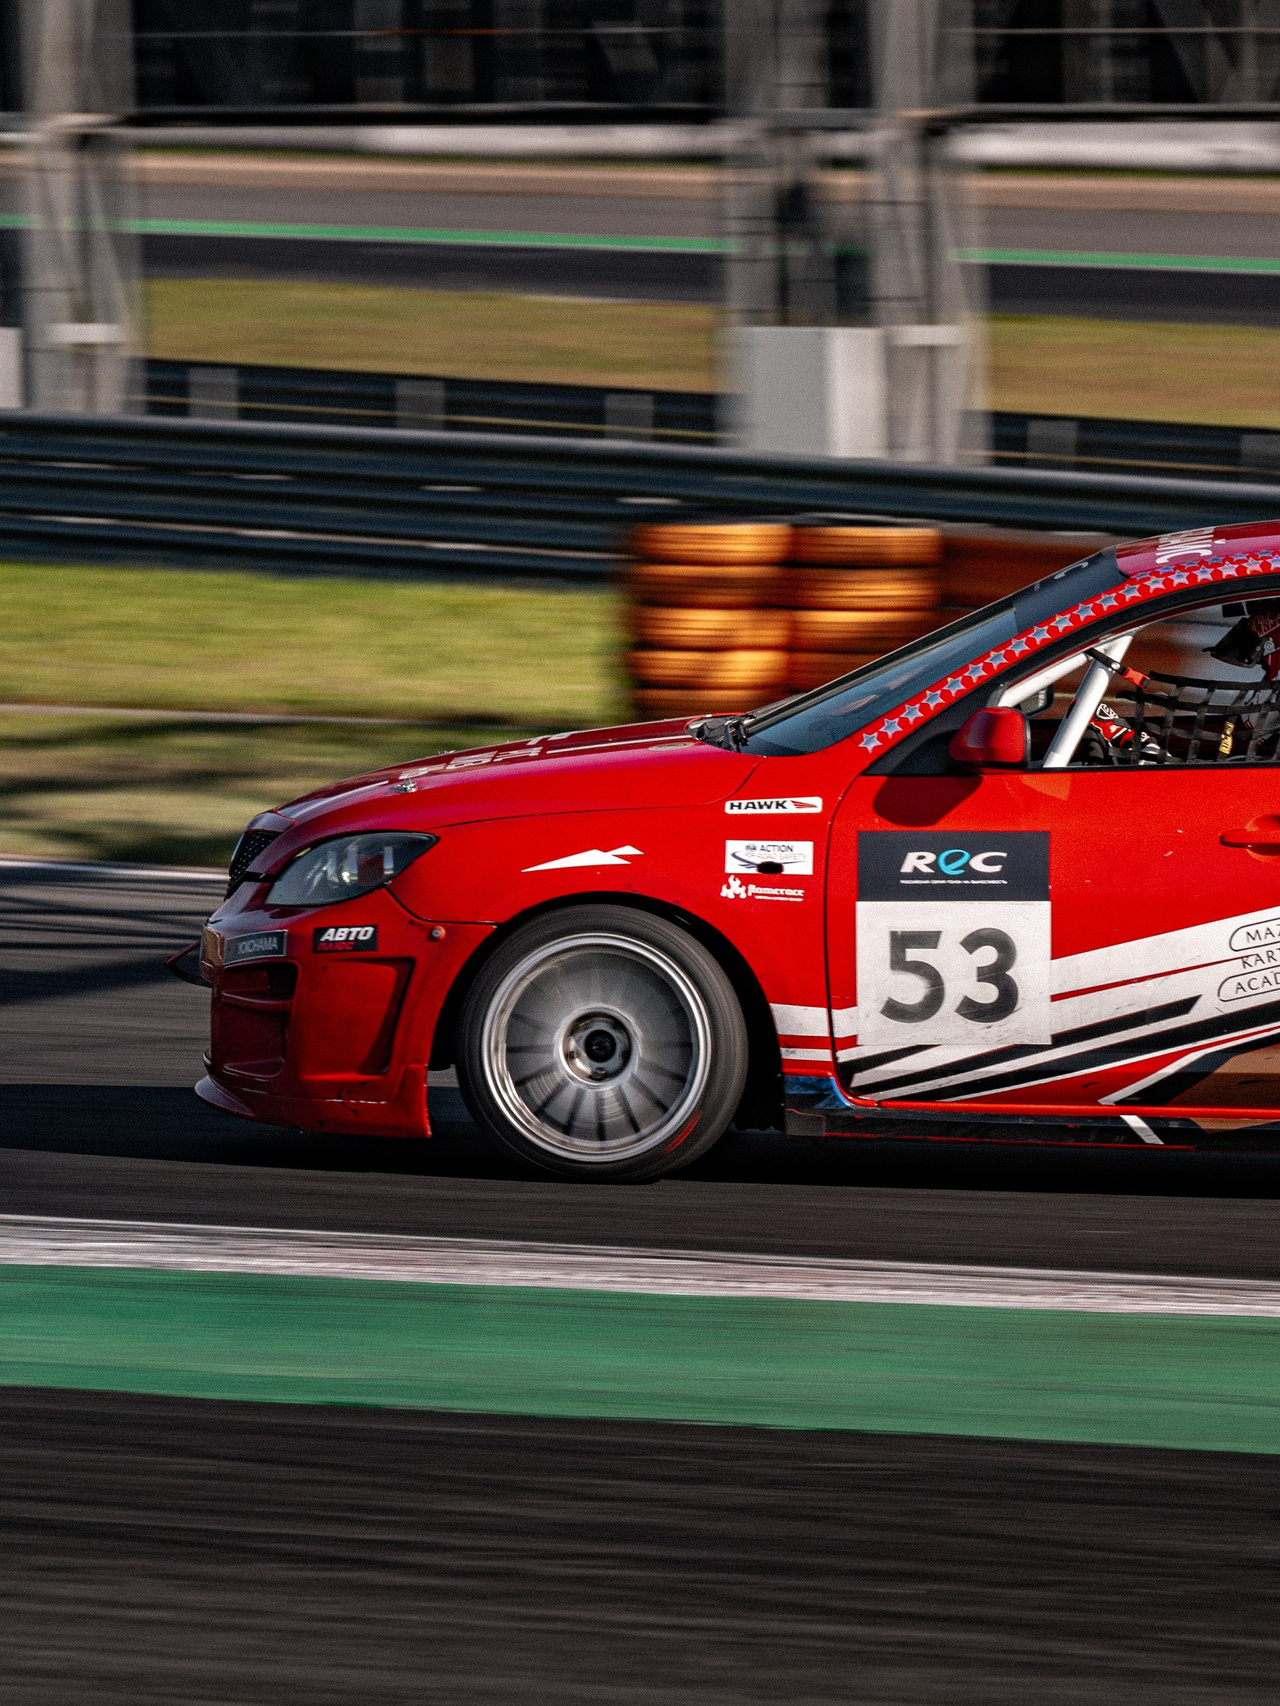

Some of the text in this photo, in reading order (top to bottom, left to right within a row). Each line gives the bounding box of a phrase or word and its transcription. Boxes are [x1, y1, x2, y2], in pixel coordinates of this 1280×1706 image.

[730, 800, 787, 810] HAWK
[760, 844, 794, 852] ACTION
[320, 927, 375, 942] АВТО
[880, 928, 1019, 1023] 53
